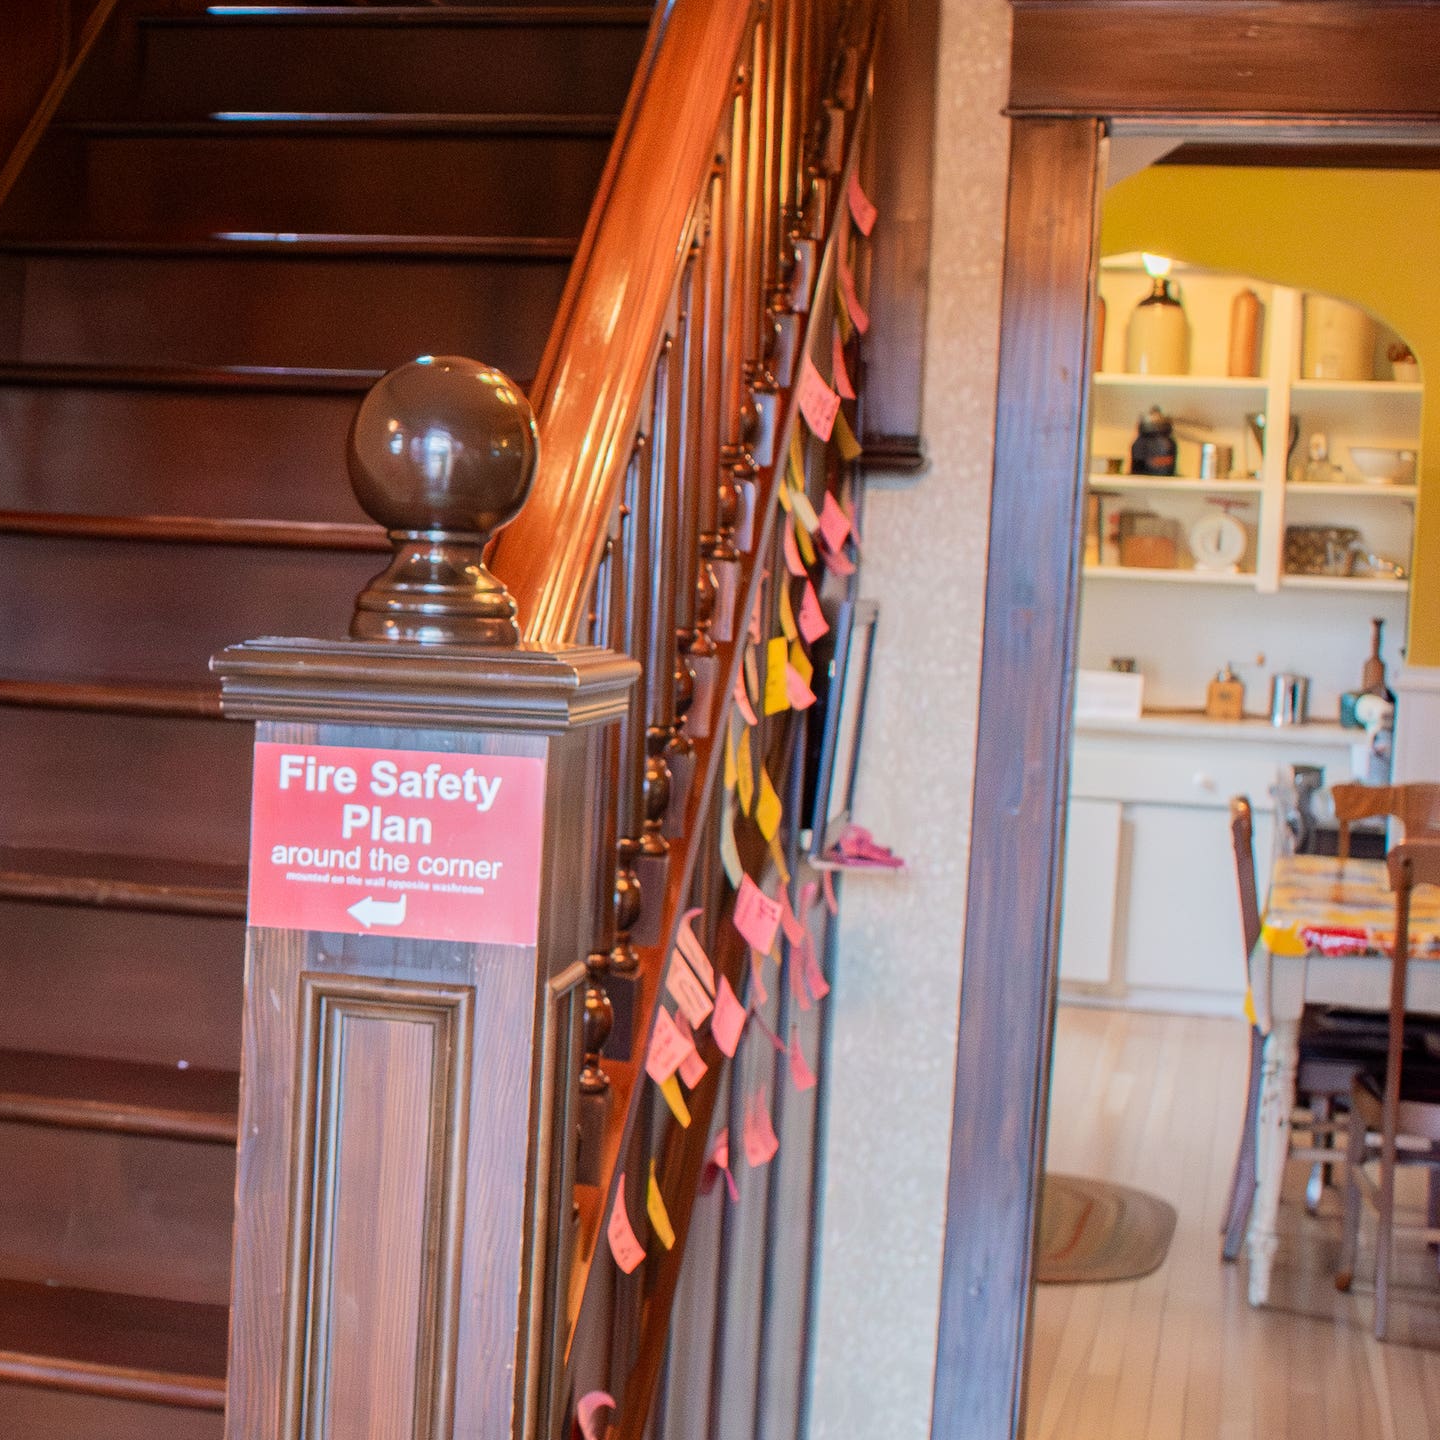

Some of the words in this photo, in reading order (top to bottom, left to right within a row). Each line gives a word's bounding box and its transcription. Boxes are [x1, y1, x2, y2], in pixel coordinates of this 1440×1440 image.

[278, 754, 358, 794] Fire
[369, 760, 502, 812] Safety
[342, 803, 432, 845] Plan
[271, 844, 361, 870] around
[369, 847, 410, 874] the
[417, 856, 503, 880] corner
[286, 871, 330, 883] mounted
[331, 875, 345, 885] on
[346, 874, 363, 885] the
[364, 877, 386, 888] wall
[387, 879, 430, 892] opposite
[432, 883, 485, 894] washroom
